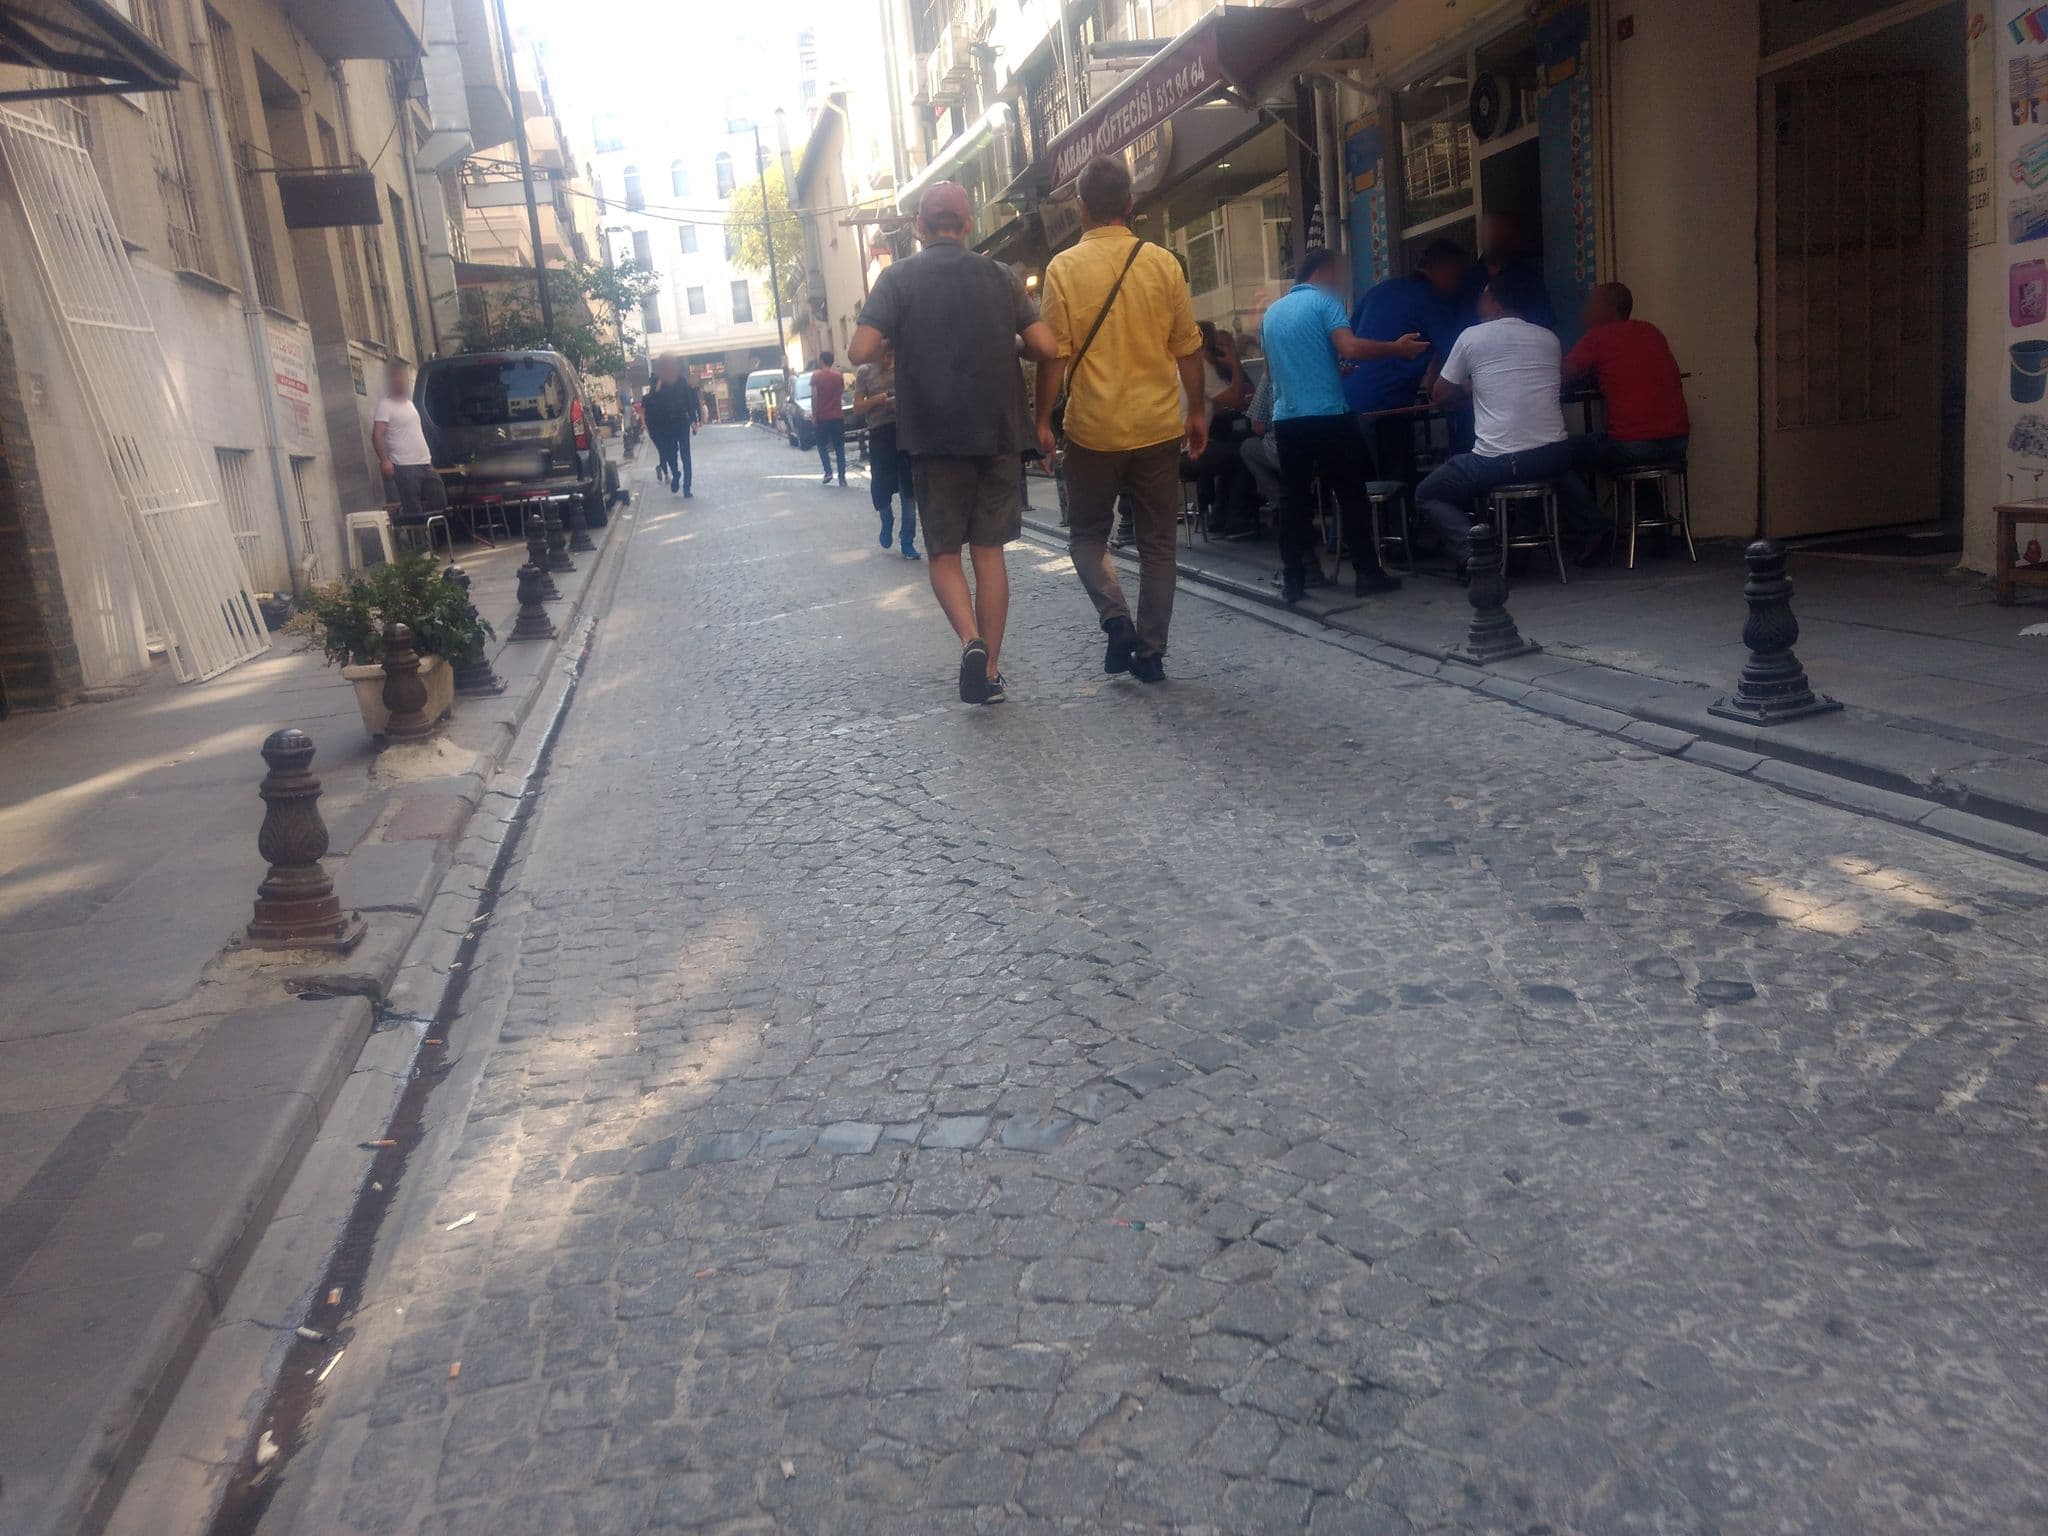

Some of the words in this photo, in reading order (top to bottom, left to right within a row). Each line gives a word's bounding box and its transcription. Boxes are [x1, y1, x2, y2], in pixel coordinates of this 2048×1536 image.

[1057, 132, 1094, 178] AKRABA
[1157, 80, 1175, 112] 513
[1176, 67, 1189, 98] 84
[1191, 56, 1205, 87] 64
